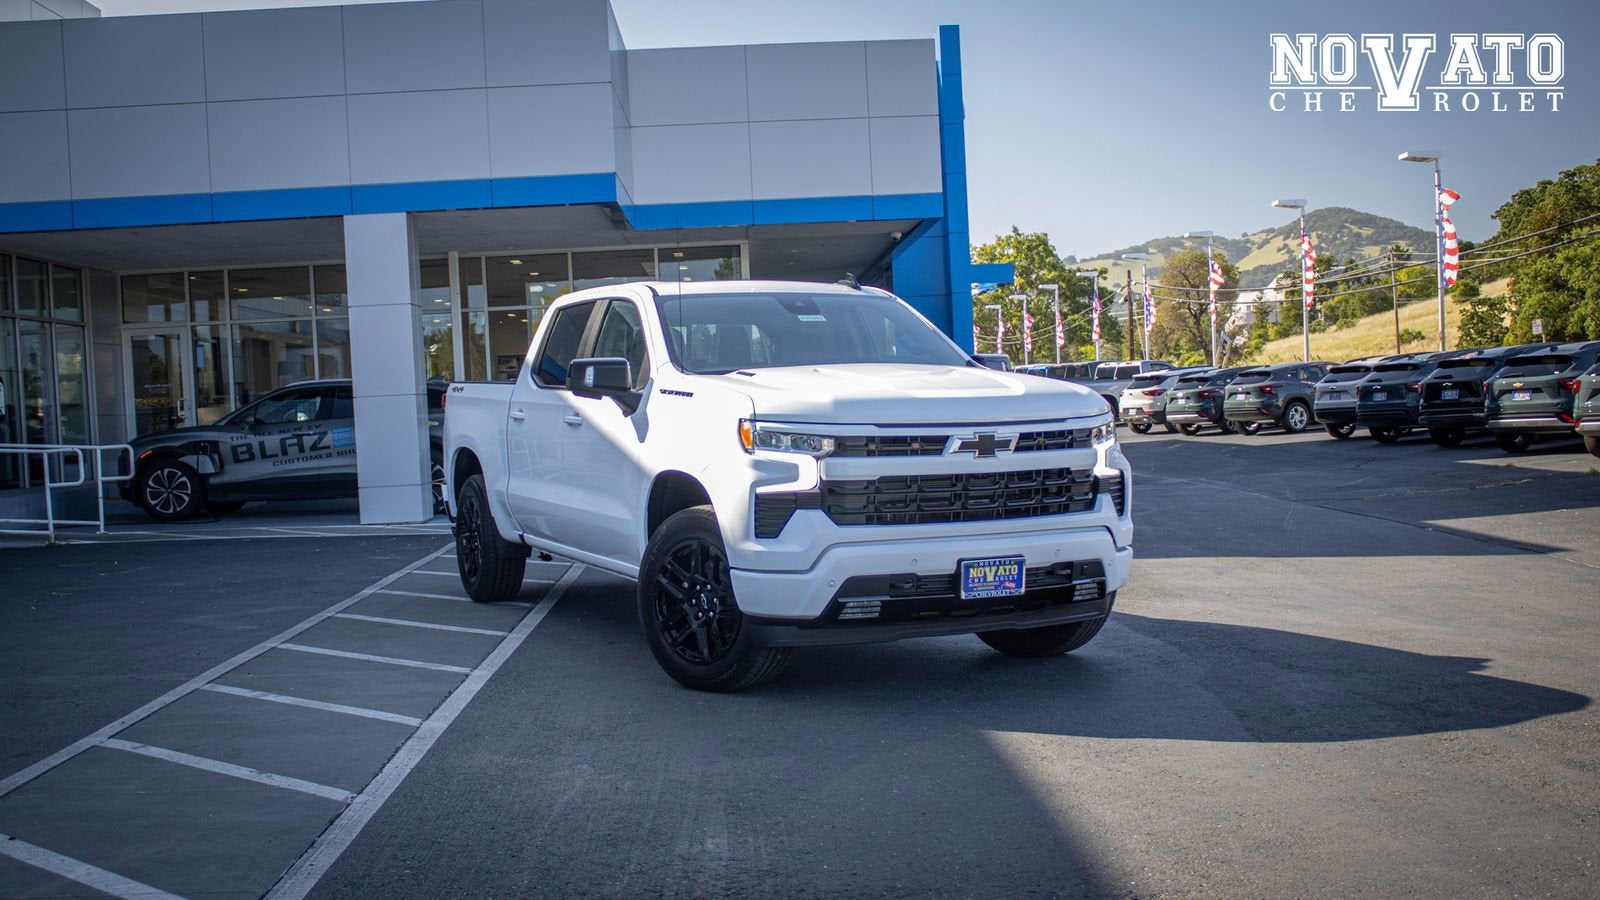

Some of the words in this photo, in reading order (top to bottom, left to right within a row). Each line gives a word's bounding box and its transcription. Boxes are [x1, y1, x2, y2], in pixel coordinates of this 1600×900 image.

[230, 433, 249, 441] THE
[279, 426, 303, 434] NEW
[272, 451, 333, 467] CUSTOMER
[969, 565, 1018, 582] NOVATO
